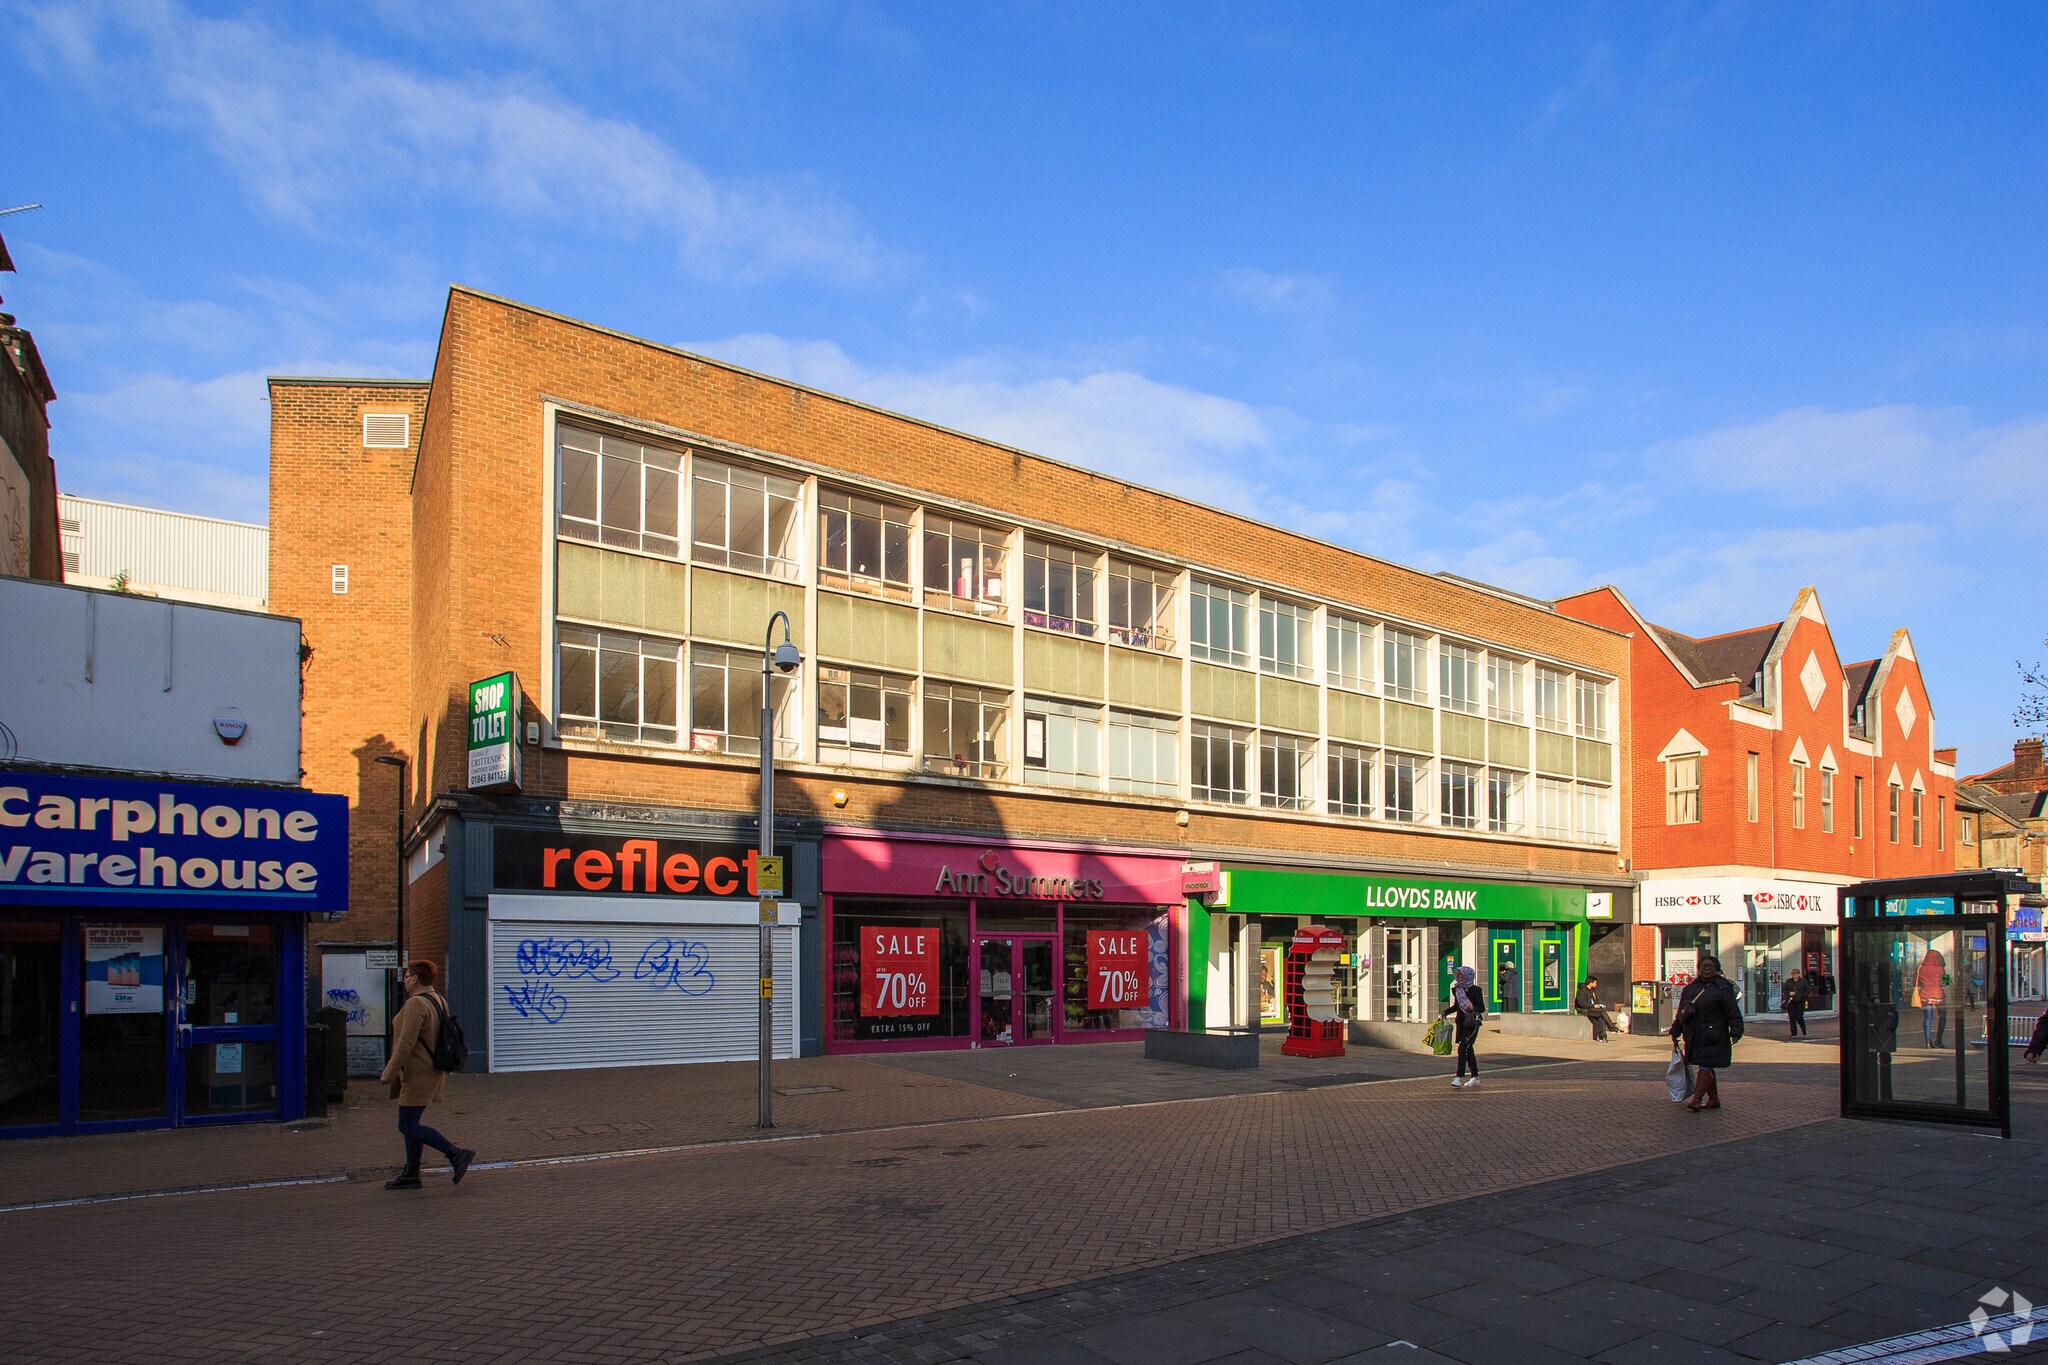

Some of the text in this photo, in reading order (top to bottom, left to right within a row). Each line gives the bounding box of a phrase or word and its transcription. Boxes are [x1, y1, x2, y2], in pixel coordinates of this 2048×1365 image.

[475, 682, 504, 714] SHOP
[472, 711, 507, 743] TO LET
[471, 754, 507, 767] CRITTENDEN
[471, 770, 507, 784] 01843 841123
[0, 786, 319, 842] Carphone
[543, 839, 759, 896] reflect
[935, 865, 1105, 899] Ann Summers
[1366, 886, 1478, 911] LLOYDS BANK
[1654, 895, 1722, 907] HSBC UK
[1809, 896, 1822, 911] UK
[876, 935, 925, 955] SALE
[1098, 937, 1137, 955] SALE
[876, 972, 927, 1009] 70%
[1099, 970, 1139, 1003] 70%
[1124, 991, 1138, 1002] OFF
[908, 997, 926, 1008] OFF
[871, 1022, 931, 1034] EXTRA 15% OFF
